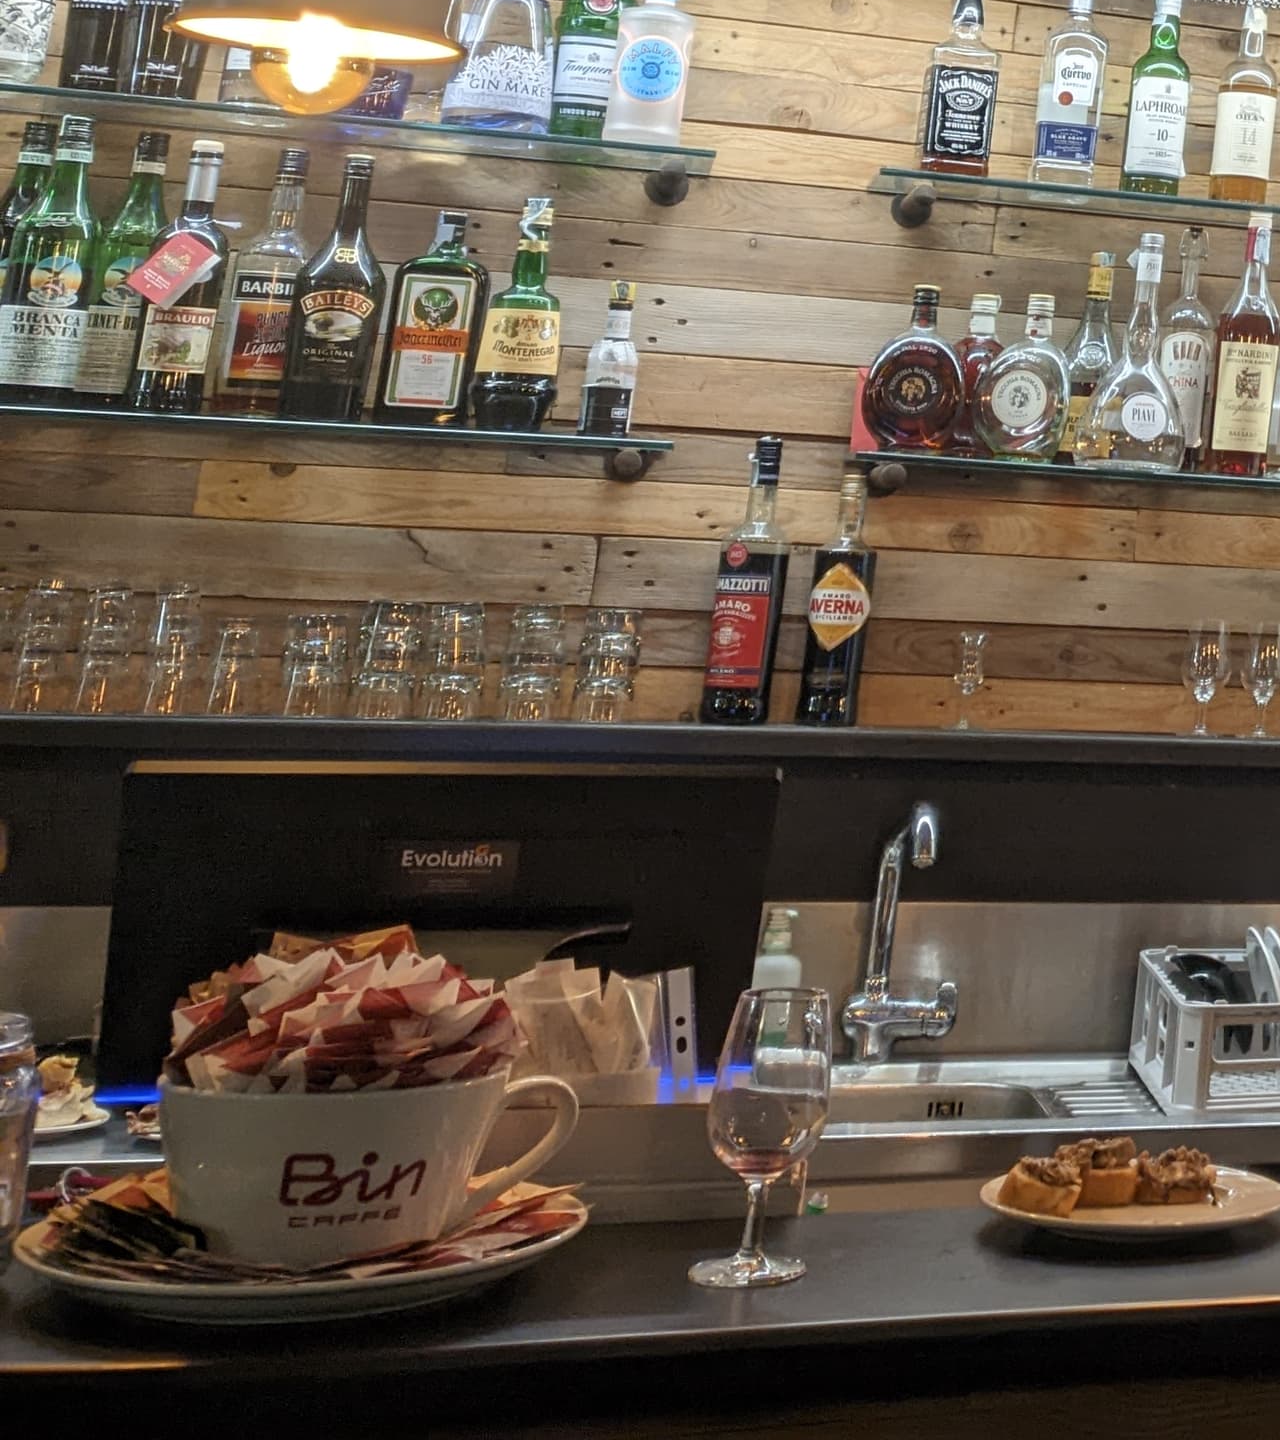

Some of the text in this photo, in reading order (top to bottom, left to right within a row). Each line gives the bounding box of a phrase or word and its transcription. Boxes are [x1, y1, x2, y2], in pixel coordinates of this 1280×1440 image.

[1060, 66, 1092, 80] Cuervo
[469, 78, 546, 97] GIN MARE
[938, 75, 993, 97] JACK DANIEL'S
[1156, 128, 1169, 143] 10
[1241, 127, 1257, 146] 14
[241, 280, 295, 296] BARBI
[304, 293, 371, 313] BAILEYS
[13, 310, 81, 327] BRANCA
[154, 312, 211, 325] BRAULIO
[12, 323, 79, 339] MENTA
[302, 347, 354, 358] ORIGINAL
[1168, 375, 1199, 388] CHINA
[822, 591, 852, 600] AMARO
[809, 598, 865, 618] AVERNA
[401, 844, 503, 868] Evolution
[279, 1151, 427, 1206] Bin
